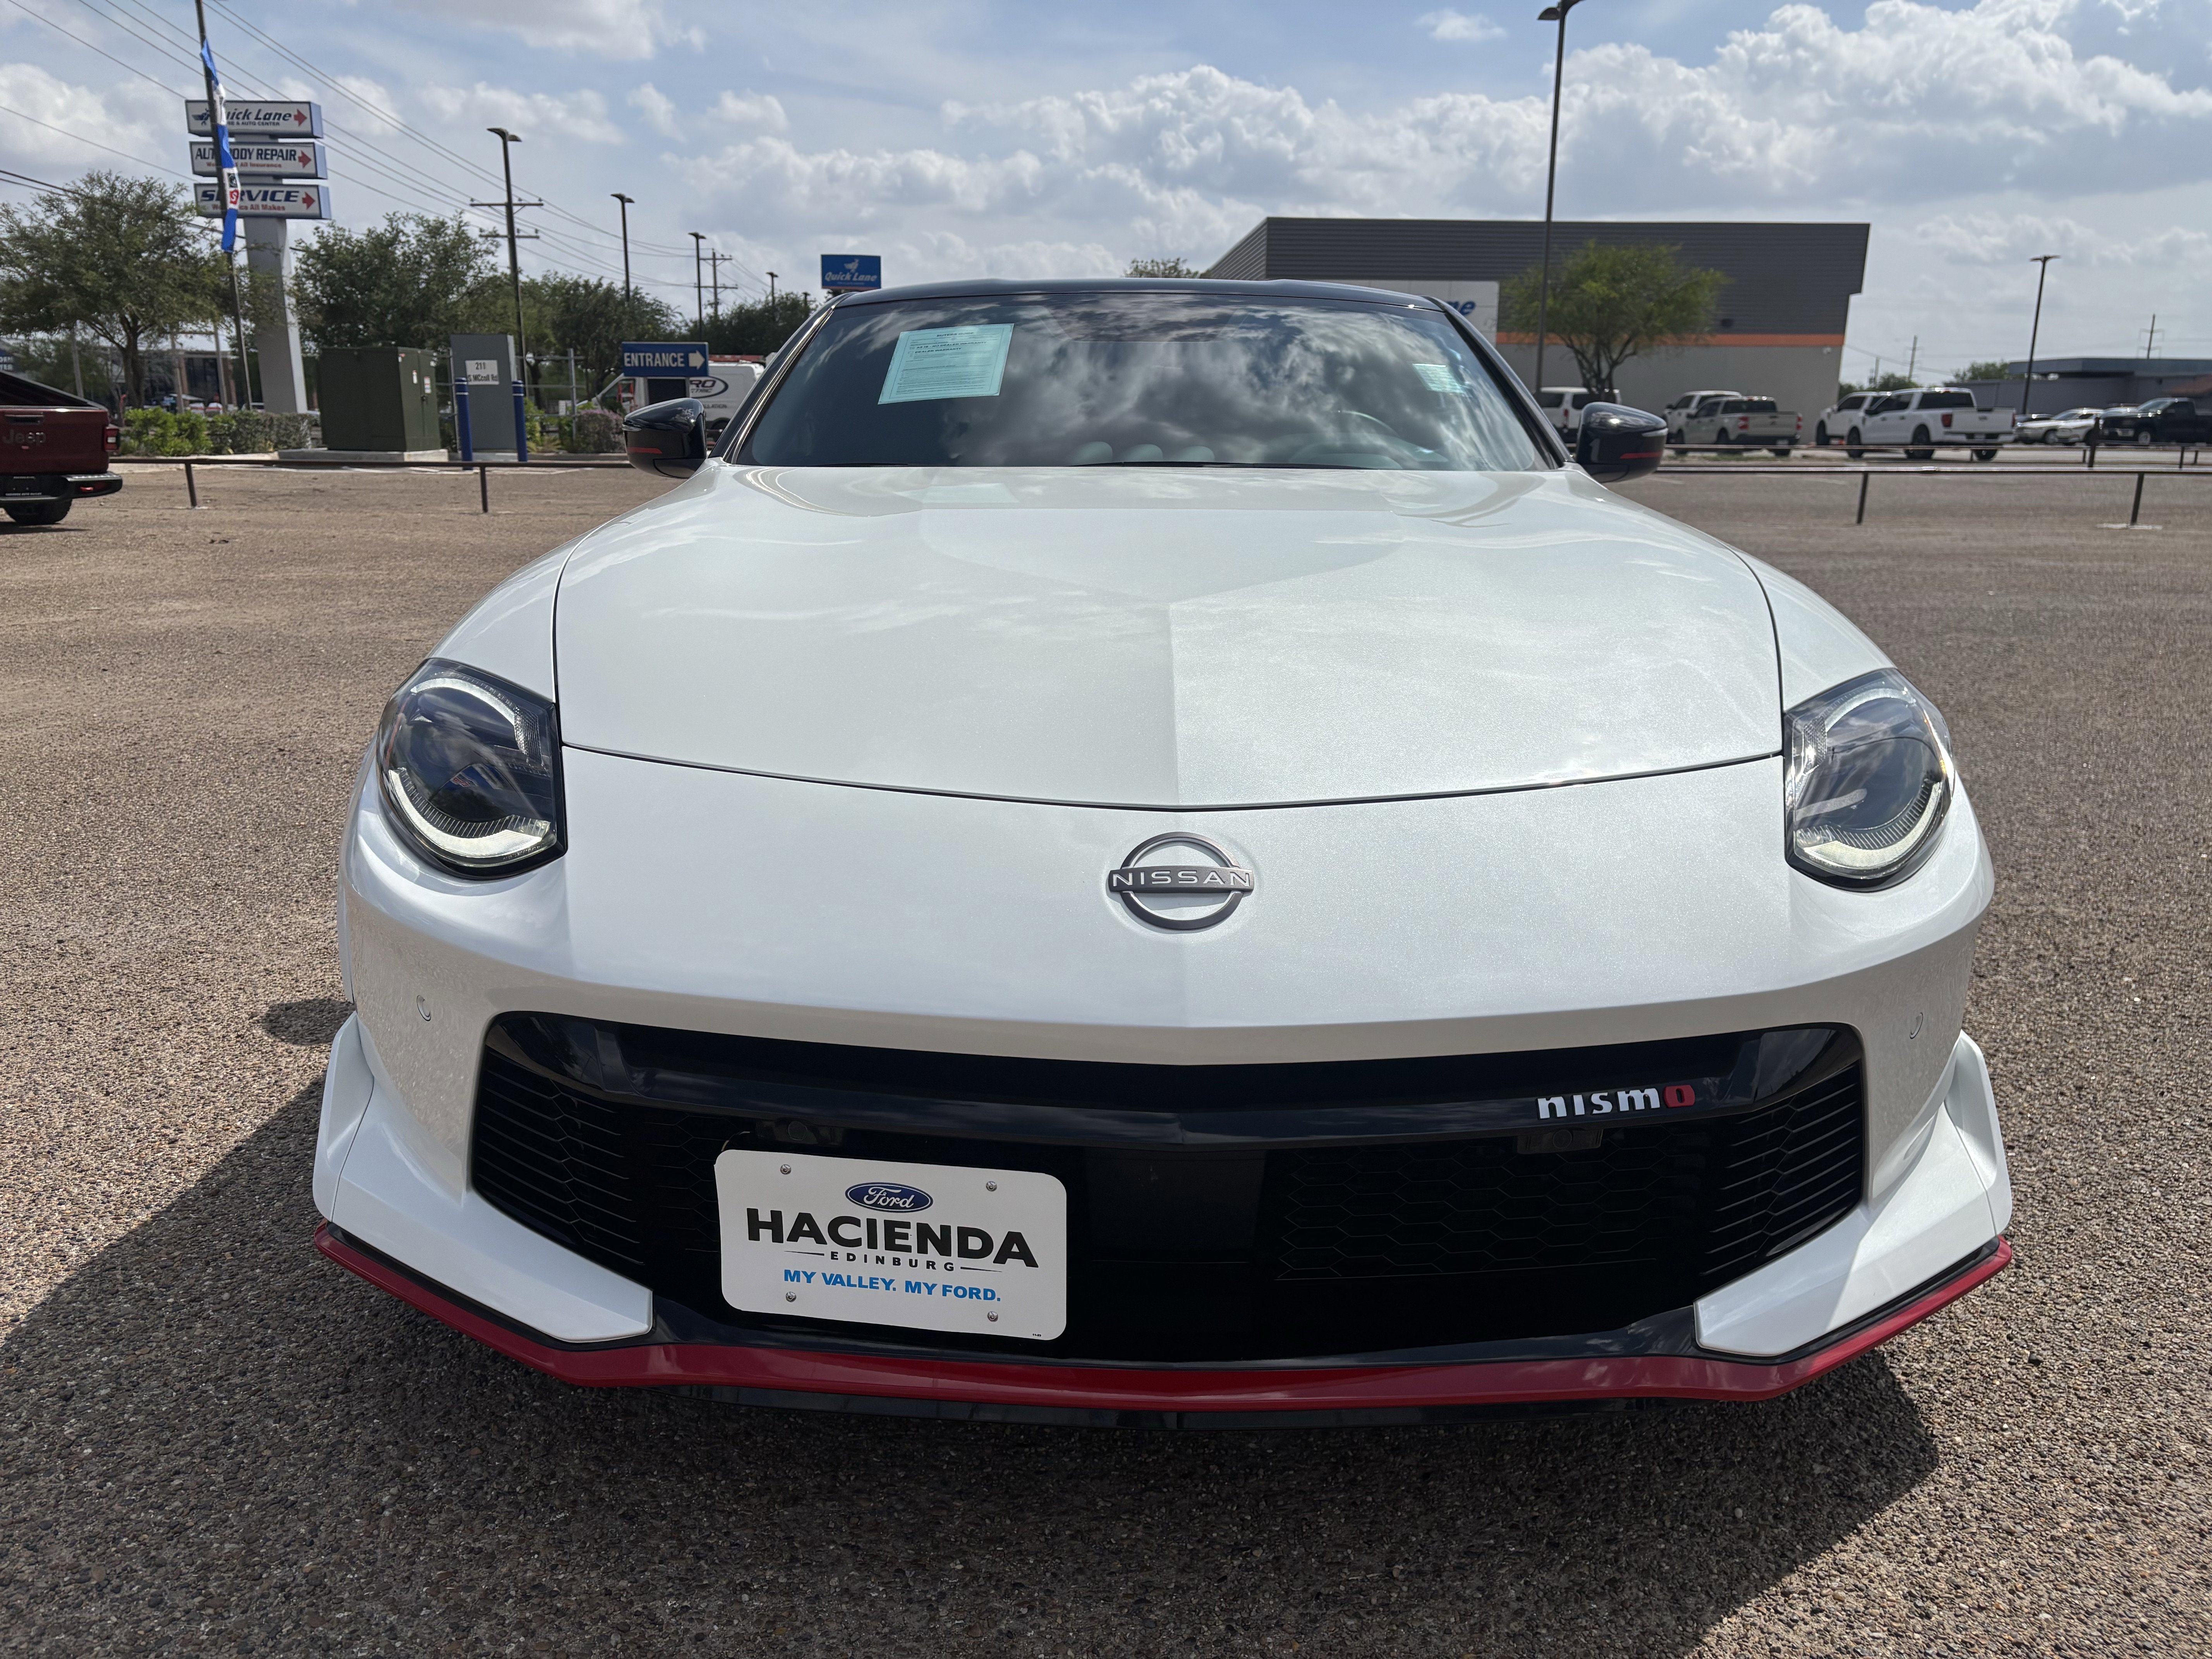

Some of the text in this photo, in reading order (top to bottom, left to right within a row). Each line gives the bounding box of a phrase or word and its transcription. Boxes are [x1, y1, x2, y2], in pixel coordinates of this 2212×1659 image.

[226, 108, 292, 121] ick Lane
[195, 148, 297, 161] AUT ODY REPAIR
[201, 190, 300, 202] SVICE
[825, 272, 878, 282] Quick Lane
[475, 362, 486, 370] 211
[624, 352, 685, 367] ENTRANCE
[2, 429, 46, 447] Jeep
[1113, 870, 1251, 887] NISSAN
[1536, 1084, 1695, 1120] nismo
[863, 1186, 915, 1209] Ford
[746, 1207, 1039, 1268] HACIENDA
[830, 1251, 955, 1272] EDINBURG
[783, 1269, 1001, 1302] MY VALLEY. MY FORD.
